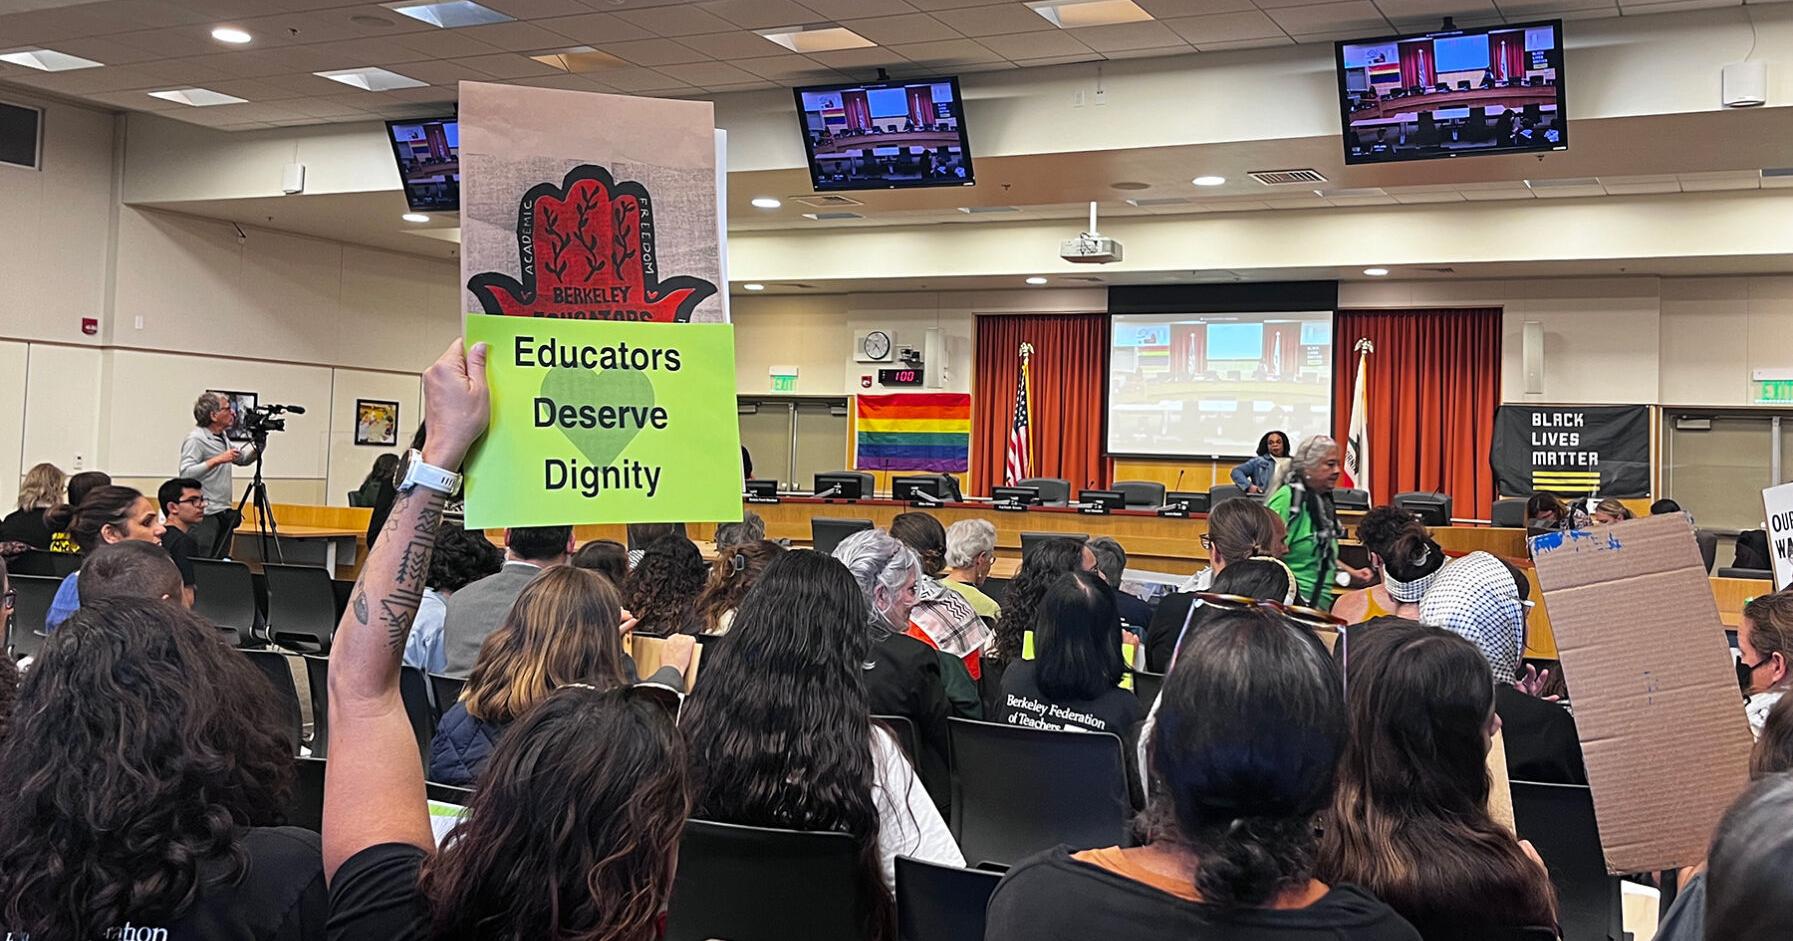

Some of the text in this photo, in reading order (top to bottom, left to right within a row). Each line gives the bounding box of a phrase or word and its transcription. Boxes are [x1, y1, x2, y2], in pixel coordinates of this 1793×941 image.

[522, 200, 533, 275] ACADEMIC
[640, 198, 654, 274] FREEDOM
[553, 286, 632, 304] BERKELEY
[515, 336, 681, 371] Educators
[896, 371, 914, 381] 100
[534, 398, 668, 429] Deserve
[1532, 413, 1584, 427] BLACK
[1532, 432, 1579, 446] LIVES
[1532, 451, 1598, 466] MATTER
[545, 459, 661, 497] Dignity
[1007, 694, 1105, 730] Berkeley Federation
[1008, 712, 1061, 731] of Teachers
